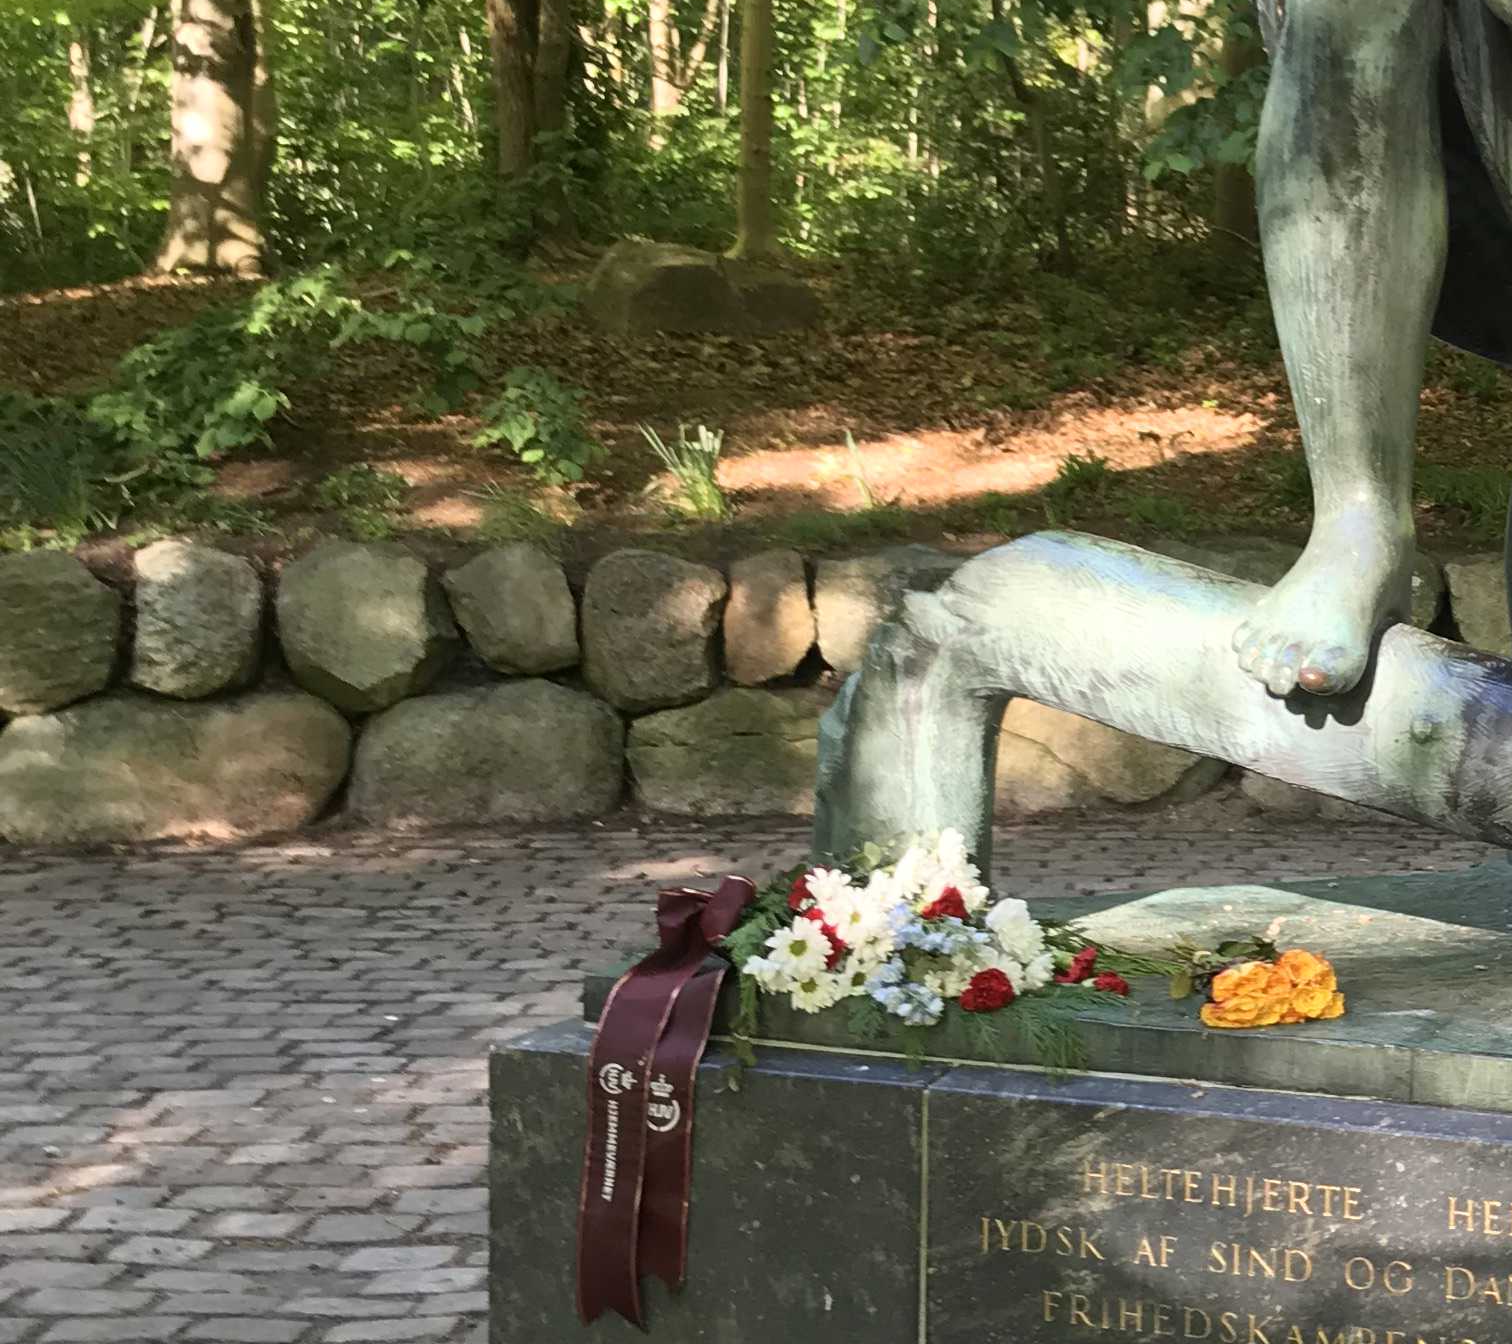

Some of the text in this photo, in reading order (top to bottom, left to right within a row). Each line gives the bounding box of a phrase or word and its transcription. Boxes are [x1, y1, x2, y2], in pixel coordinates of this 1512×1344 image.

[1083, 1158, 1362, 1220] HELTEHJERTE
[978, 1216, 1105, 1260] JYDSK
[1133, 1235, 1178, 1267] AF
[1208, 1240, 1313, 1283] SIND
[1344, 1256, 1413, 1296] OG
